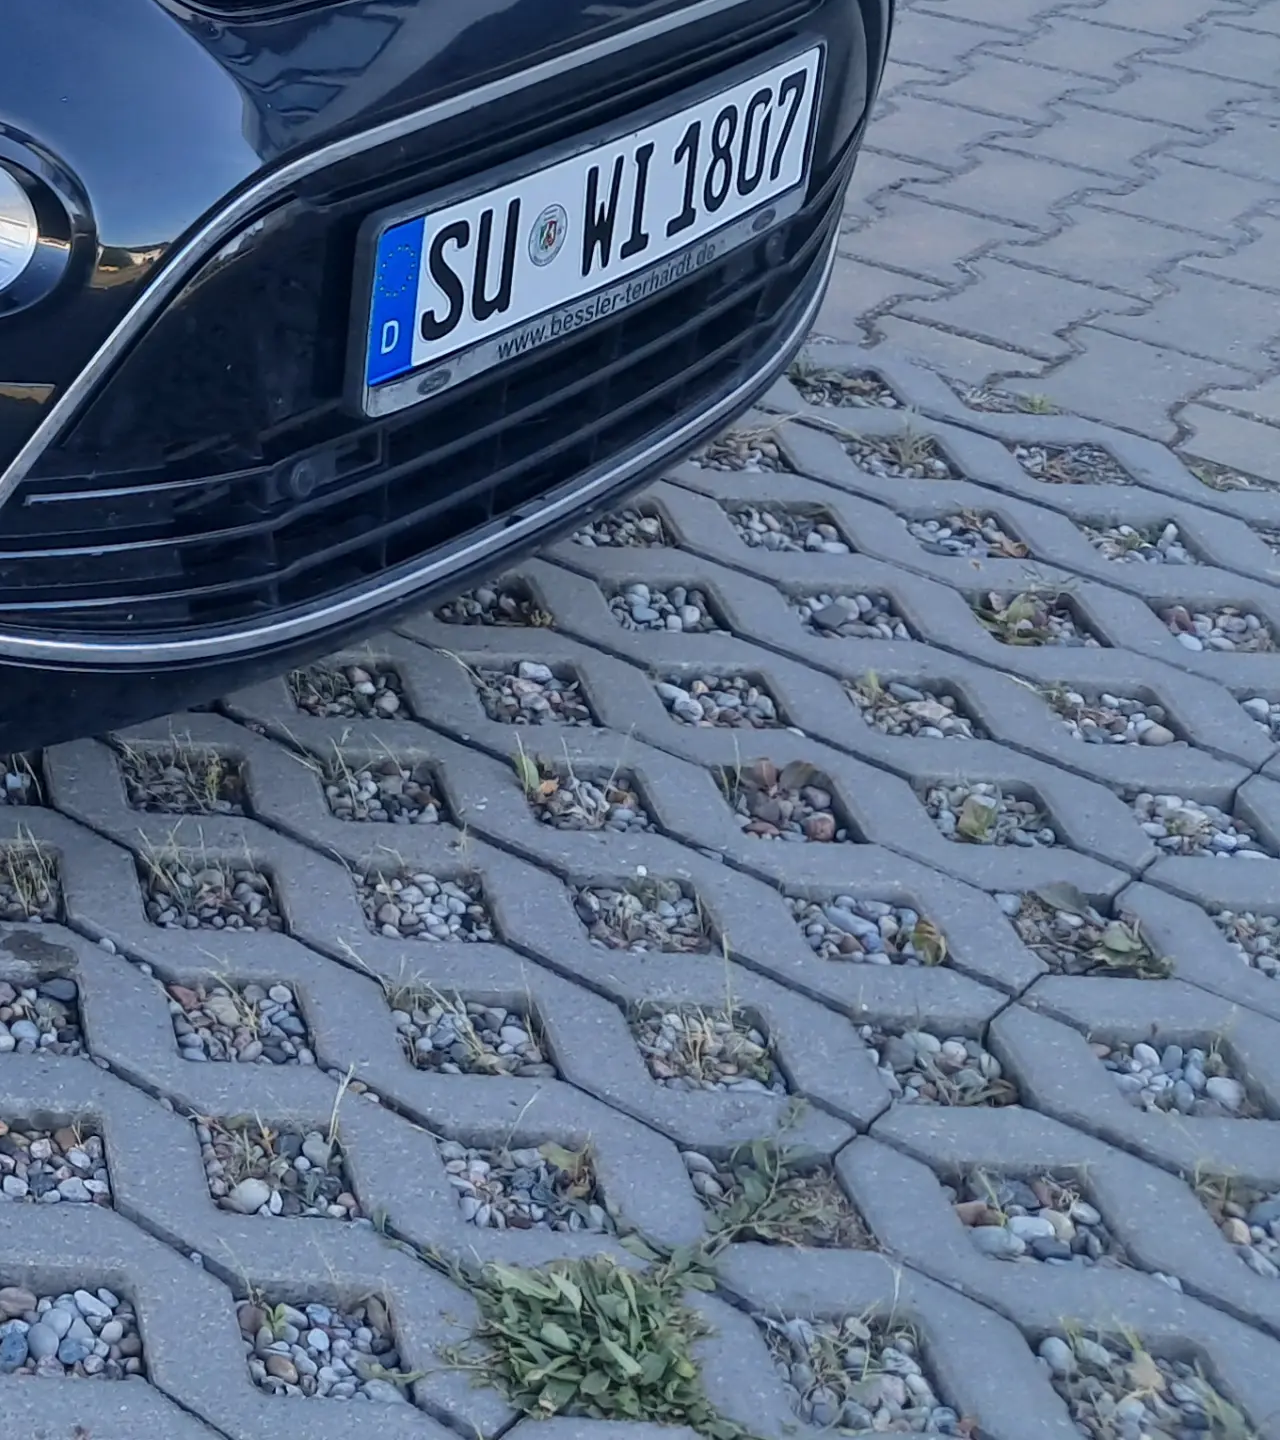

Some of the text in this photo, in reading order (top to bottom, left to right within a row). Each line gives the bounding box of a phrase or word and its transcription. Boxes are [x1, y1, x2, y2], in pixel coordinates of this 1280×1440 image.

[420, 67, 808, 341] SU WI 1807
[380, 320, 400, 356] D
[497, 242, 717, 360] www.bessler-terhardt.de
